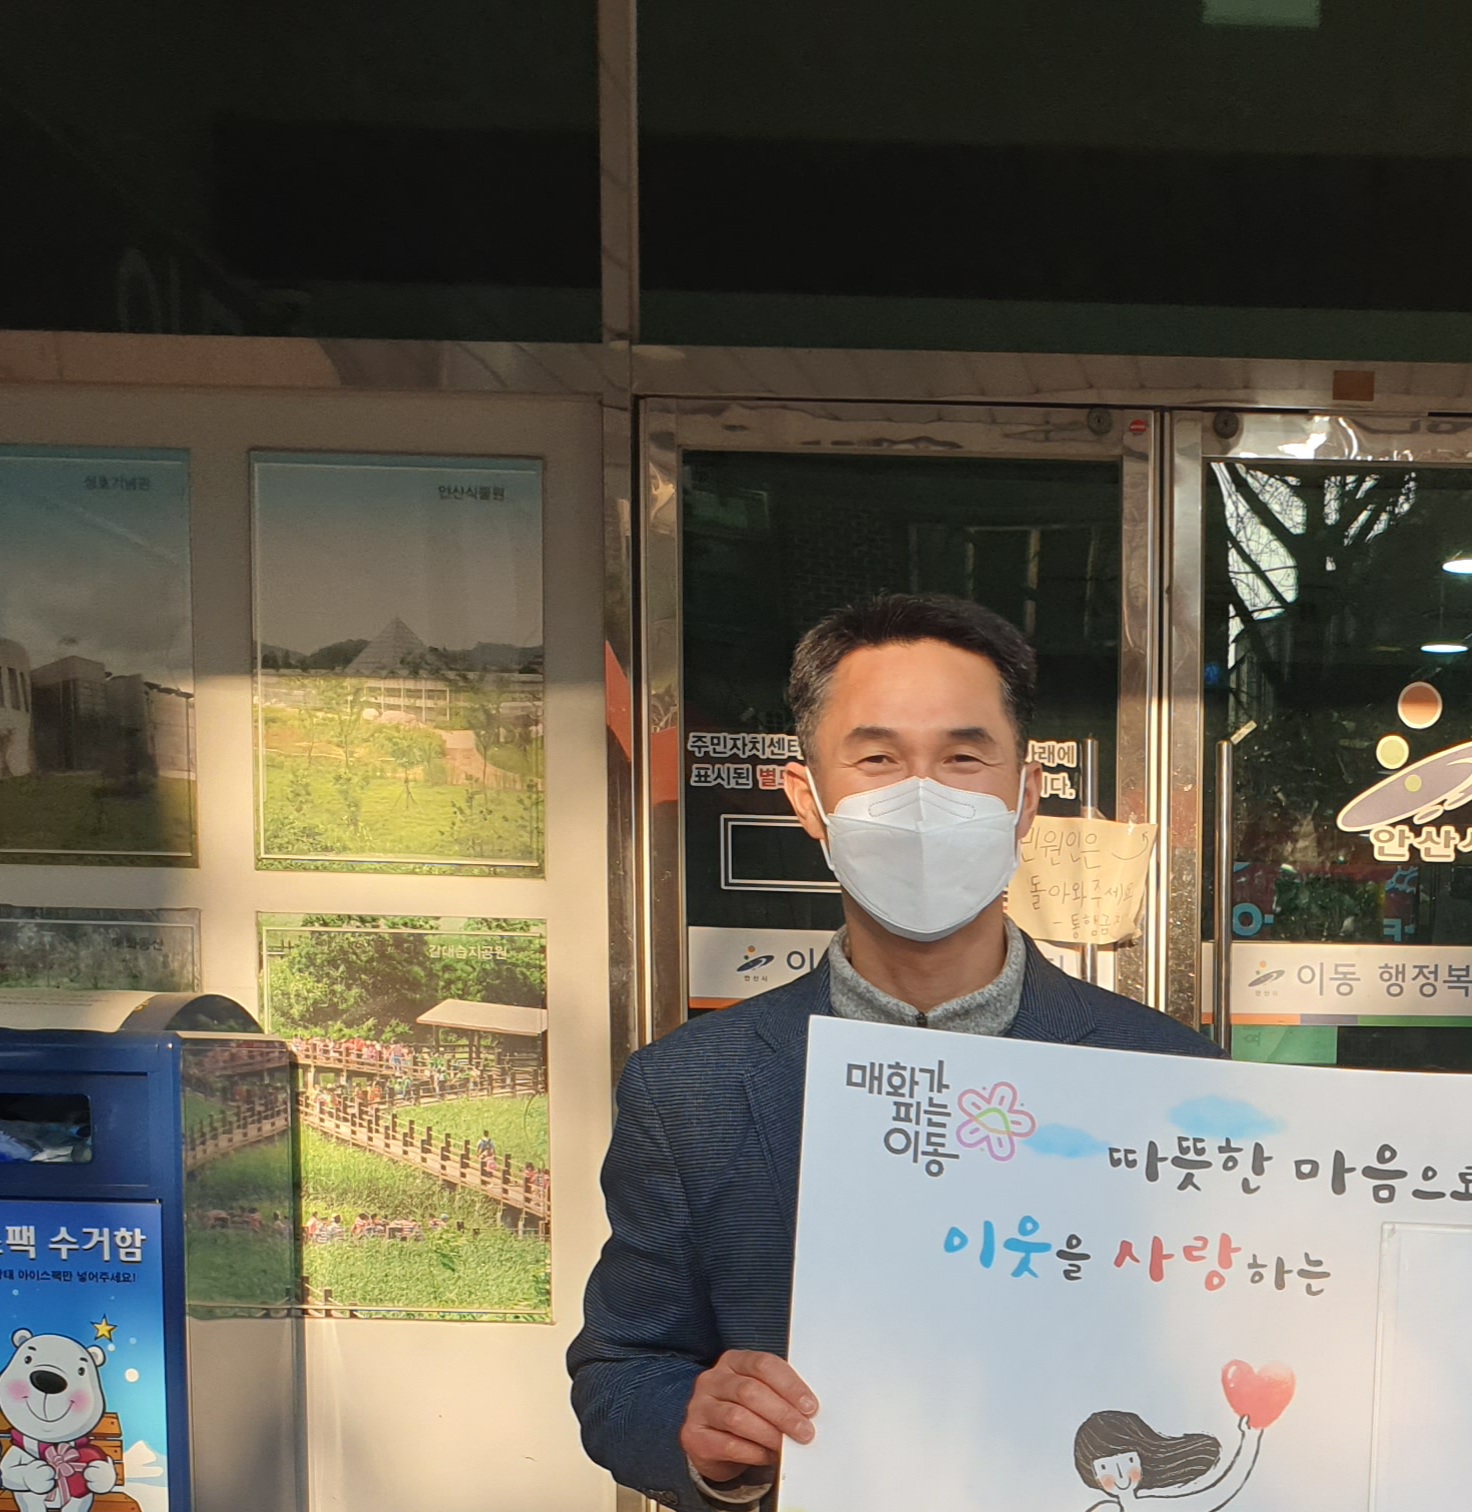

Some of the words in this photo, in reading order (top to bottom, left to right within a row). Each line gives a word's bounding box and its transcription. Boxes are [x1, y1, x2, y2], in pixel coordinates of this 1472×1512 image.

[691, 763, 752, 789] 표시된
[428, 944, 507, 960] 갈대습지공원
[1296, 961, 1361, 997] 이동
[846, 1059, 950, 1099] 매화가
[892, 1096, 952, 1129] 피는
[883, 1127, 960, 1178] 이동
[1107, 1135, 1273, 1195] 따뜻한
[0, 1225, 37, 1260] 팩
[48, 1226, 147, 1263] 수거함
[943, 1214, 1092, 1281] 이웃을
[1113, 1232, 1332, 1296] 사랑하는
[18, 1269, 73, 1282] 아이스팩만
